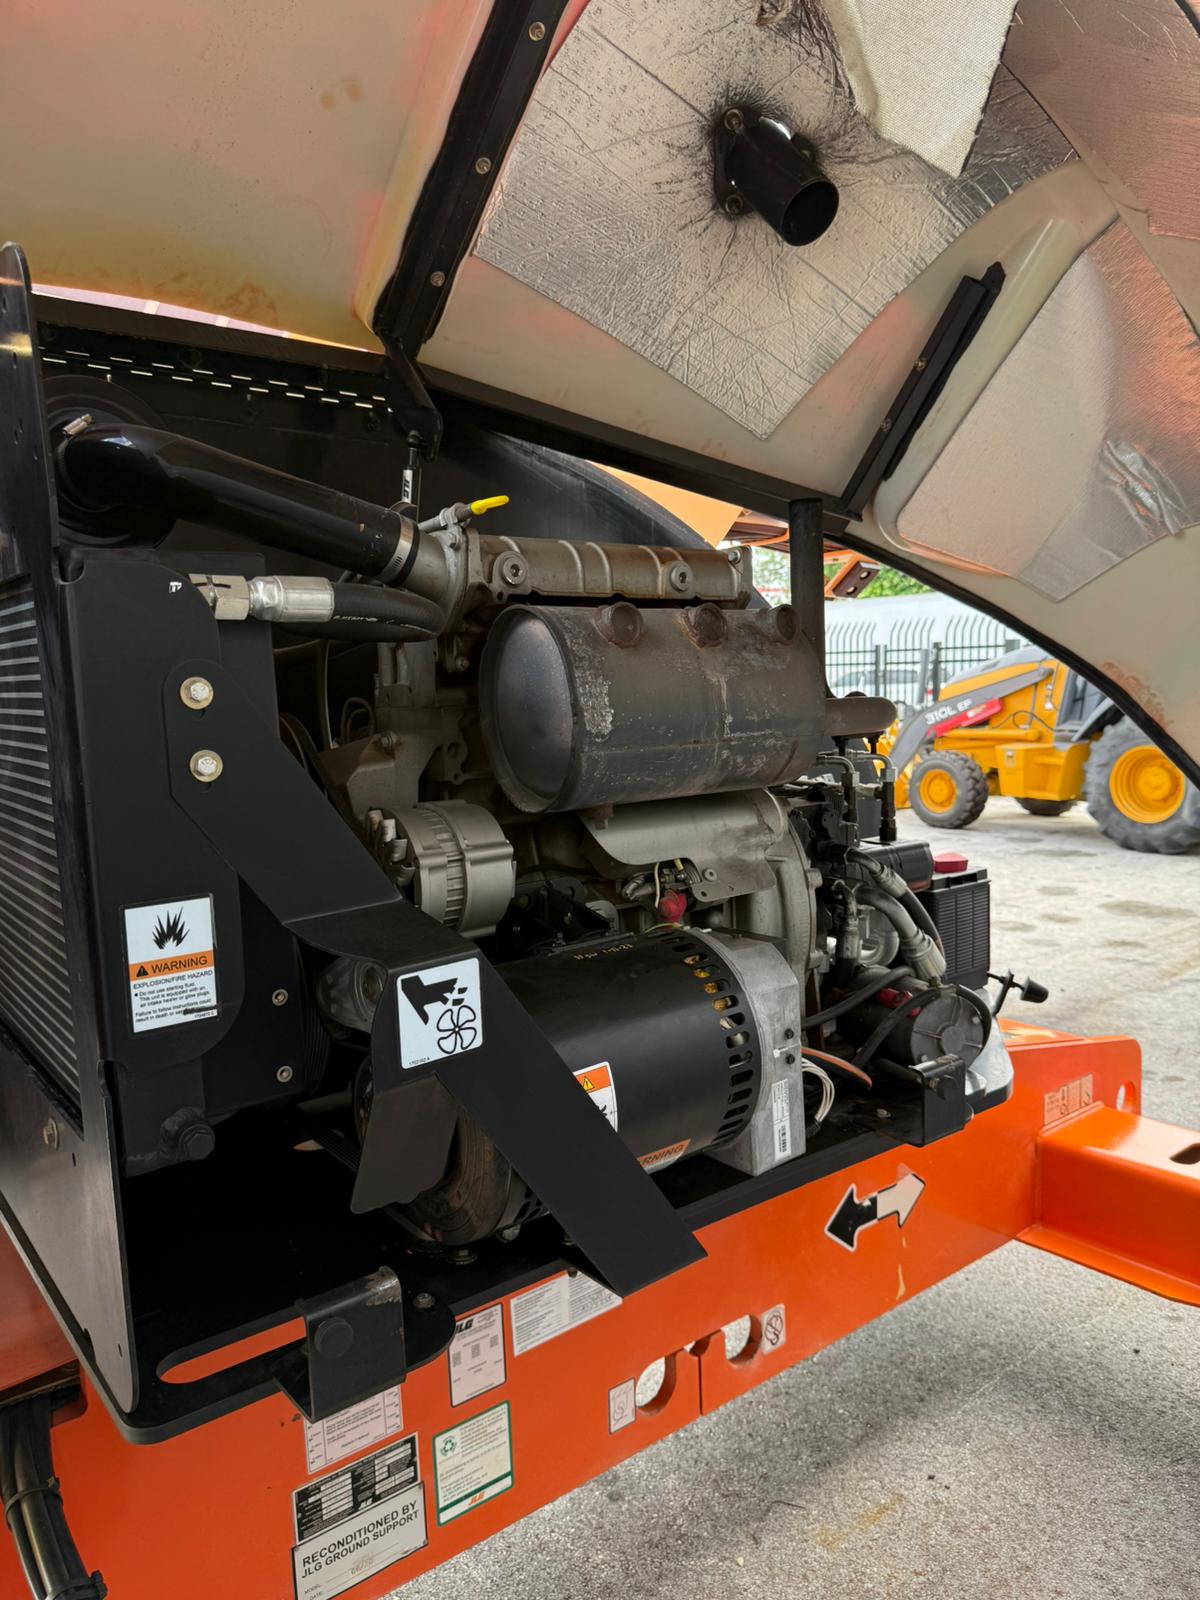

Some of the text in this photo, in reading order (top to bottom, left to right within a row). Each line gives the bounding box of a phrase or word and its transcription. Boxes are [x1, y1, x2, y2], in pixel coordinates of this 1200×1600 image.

[924, 705, 957, 725] 310L
[151, 956, 208, 974] WARNING
[133, 970, 213, 989] EXPLOSION/FIRE HAZARD
[172, 1001, 198, 1009] instructions
[302, 1509, 400, 1568] RECONDITIONED
[401, 1500, 418, 1516] BY
[301, 1561, 323, 1579] JLG
[324, 1536, 371, 1567] GROUND
[372, 1509, 420, 1541] SUPPORT
